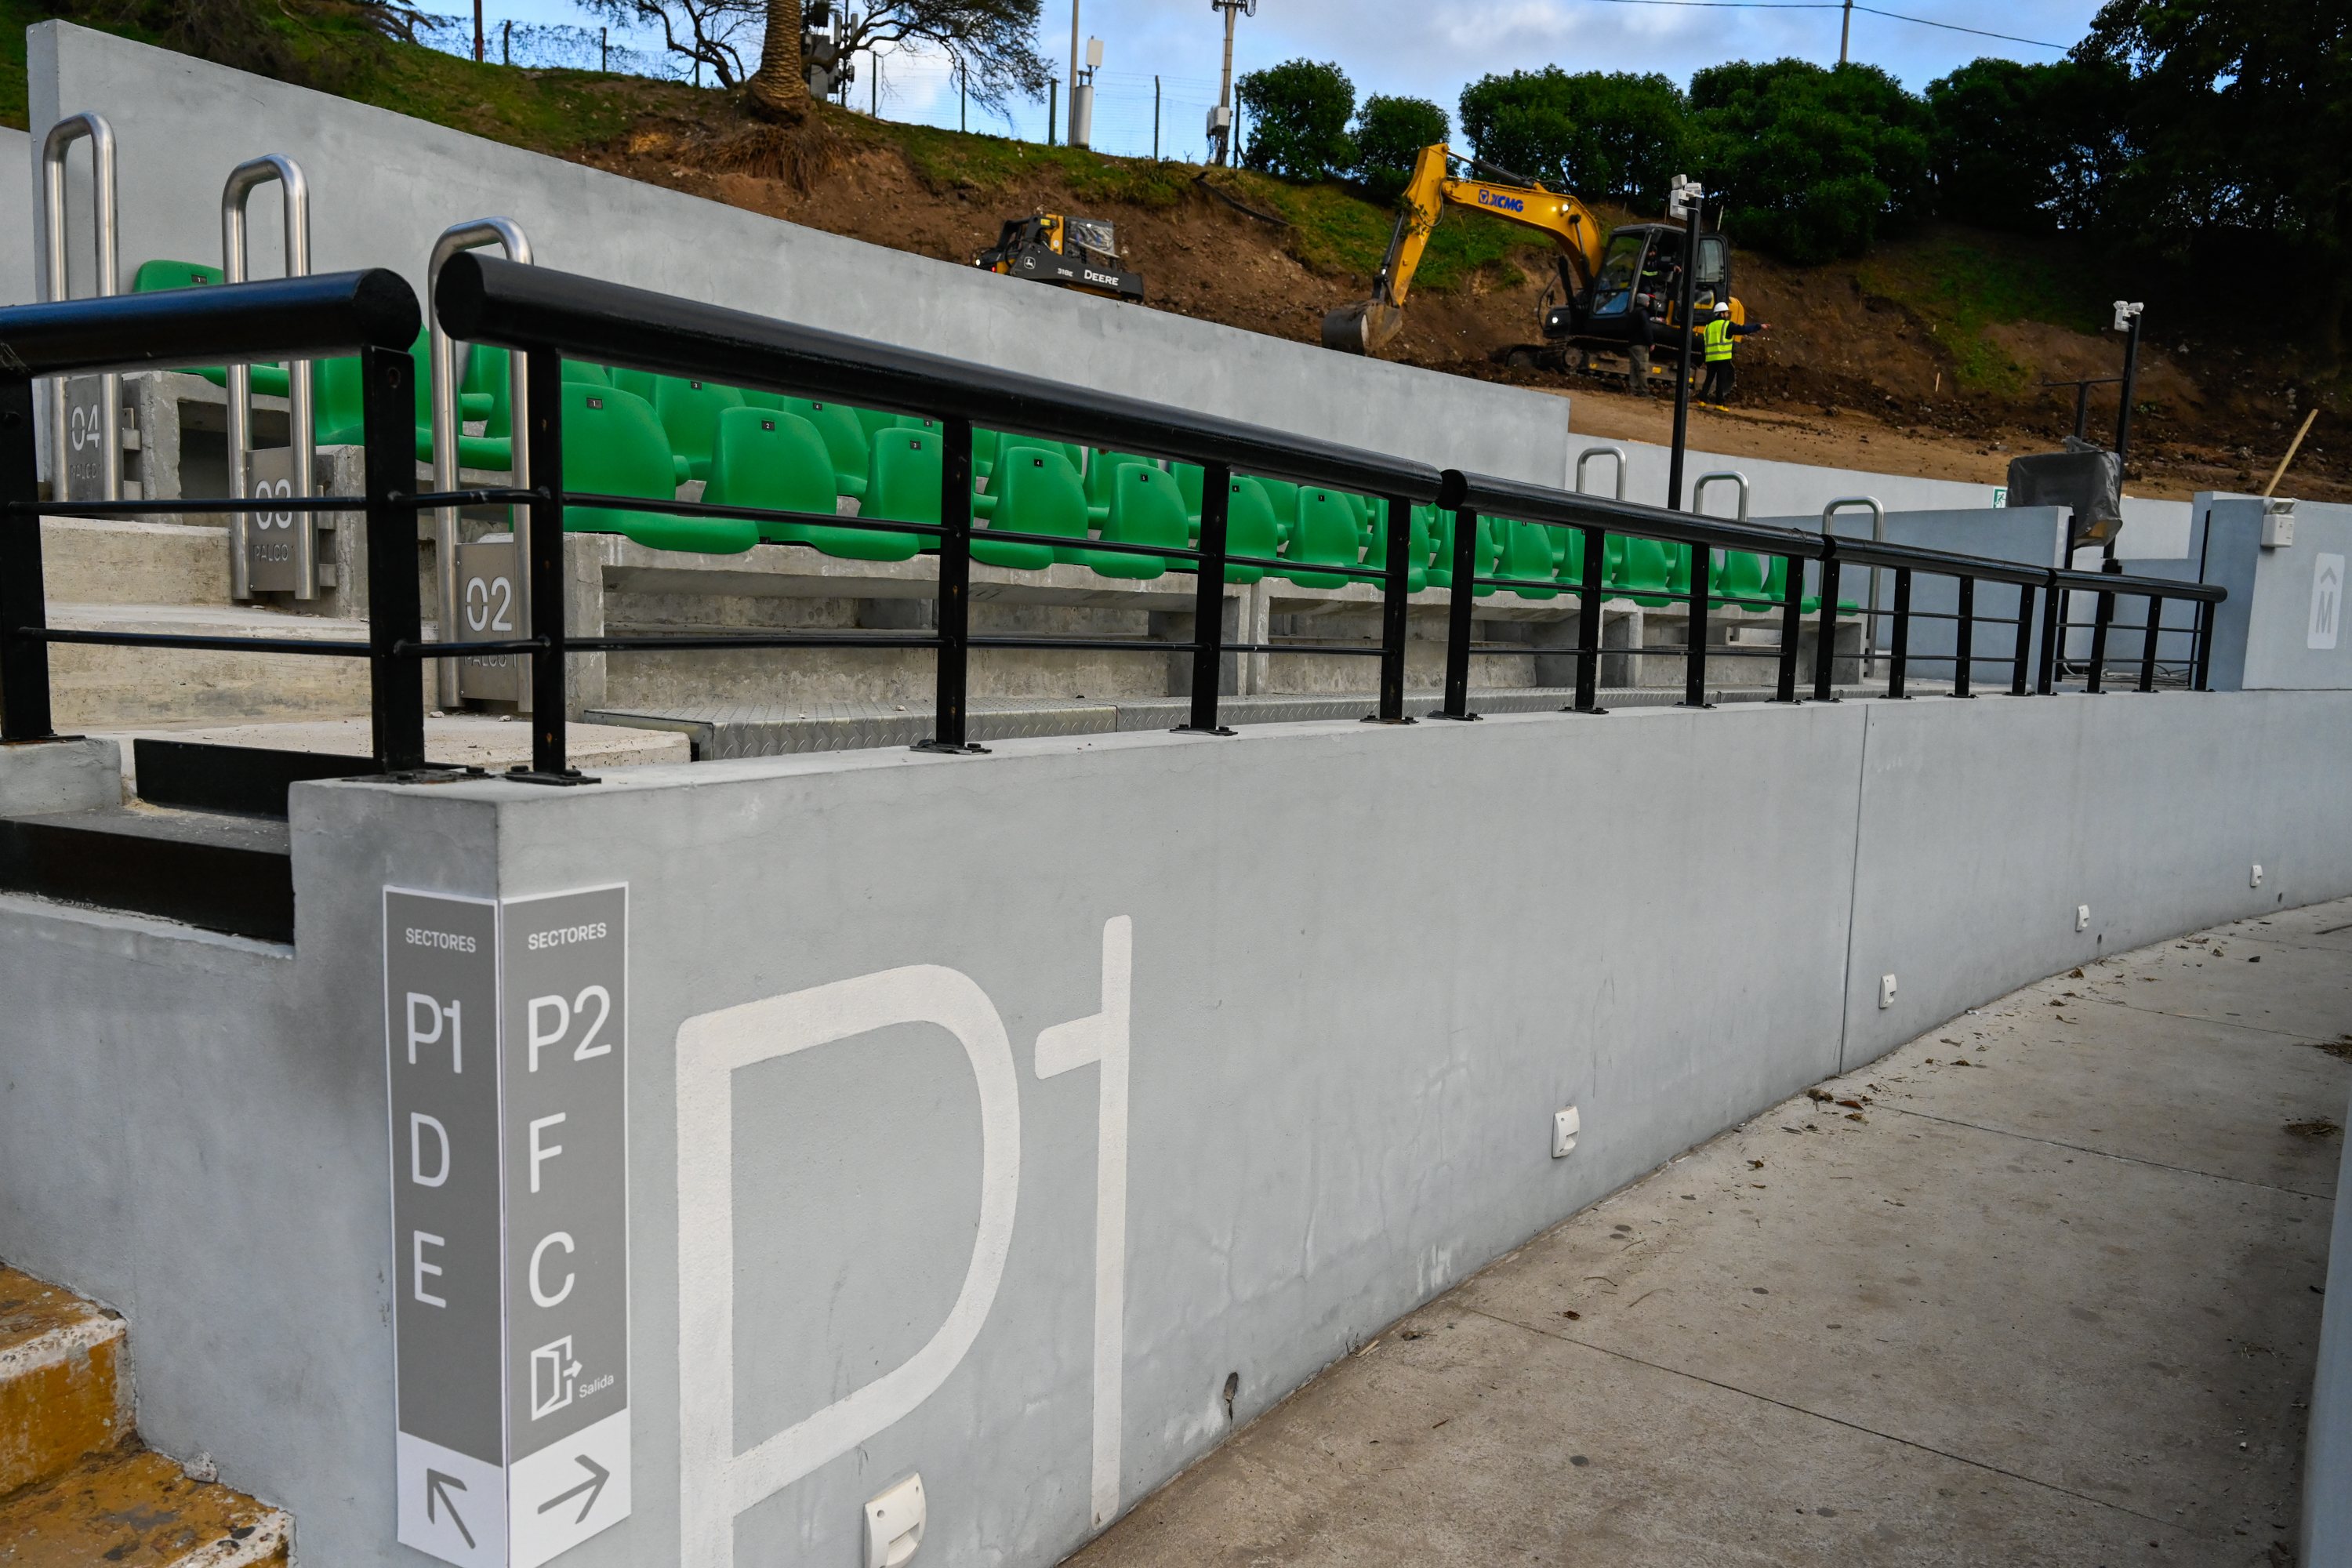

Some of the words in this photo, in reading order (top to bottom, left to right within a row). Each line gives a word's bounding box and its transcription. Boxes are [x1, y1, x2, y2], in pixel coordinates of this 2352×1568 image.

[1490, 193, 1524, 212] XCMG
[1083, 269, 1120, 286] DEERE
[71, 404, 100, 451] 04
[70, 463, 97, 479] PALCO
[255, 478, 292, 529] 03
[252, 543, 289, 561] PALCO
[466, 576, 512, 632] 02
[2315, 590, 2334, 633] M
[405, 927, 476, 953] SECTORES
[528, 922, 607, 950] SECTORES
[407, 992, 462, 1074] P1
[528, 985, 612, 1073] P2
[411, 1112, 450, 1188] D
[529, 1112, 566, 1193] F
[676, 914, 1132, 1568] P1
[414, 1230, 446, 1308] E
[529, 1231, 575, 1308] C
[579, 1374, 615, 1399] Salida
